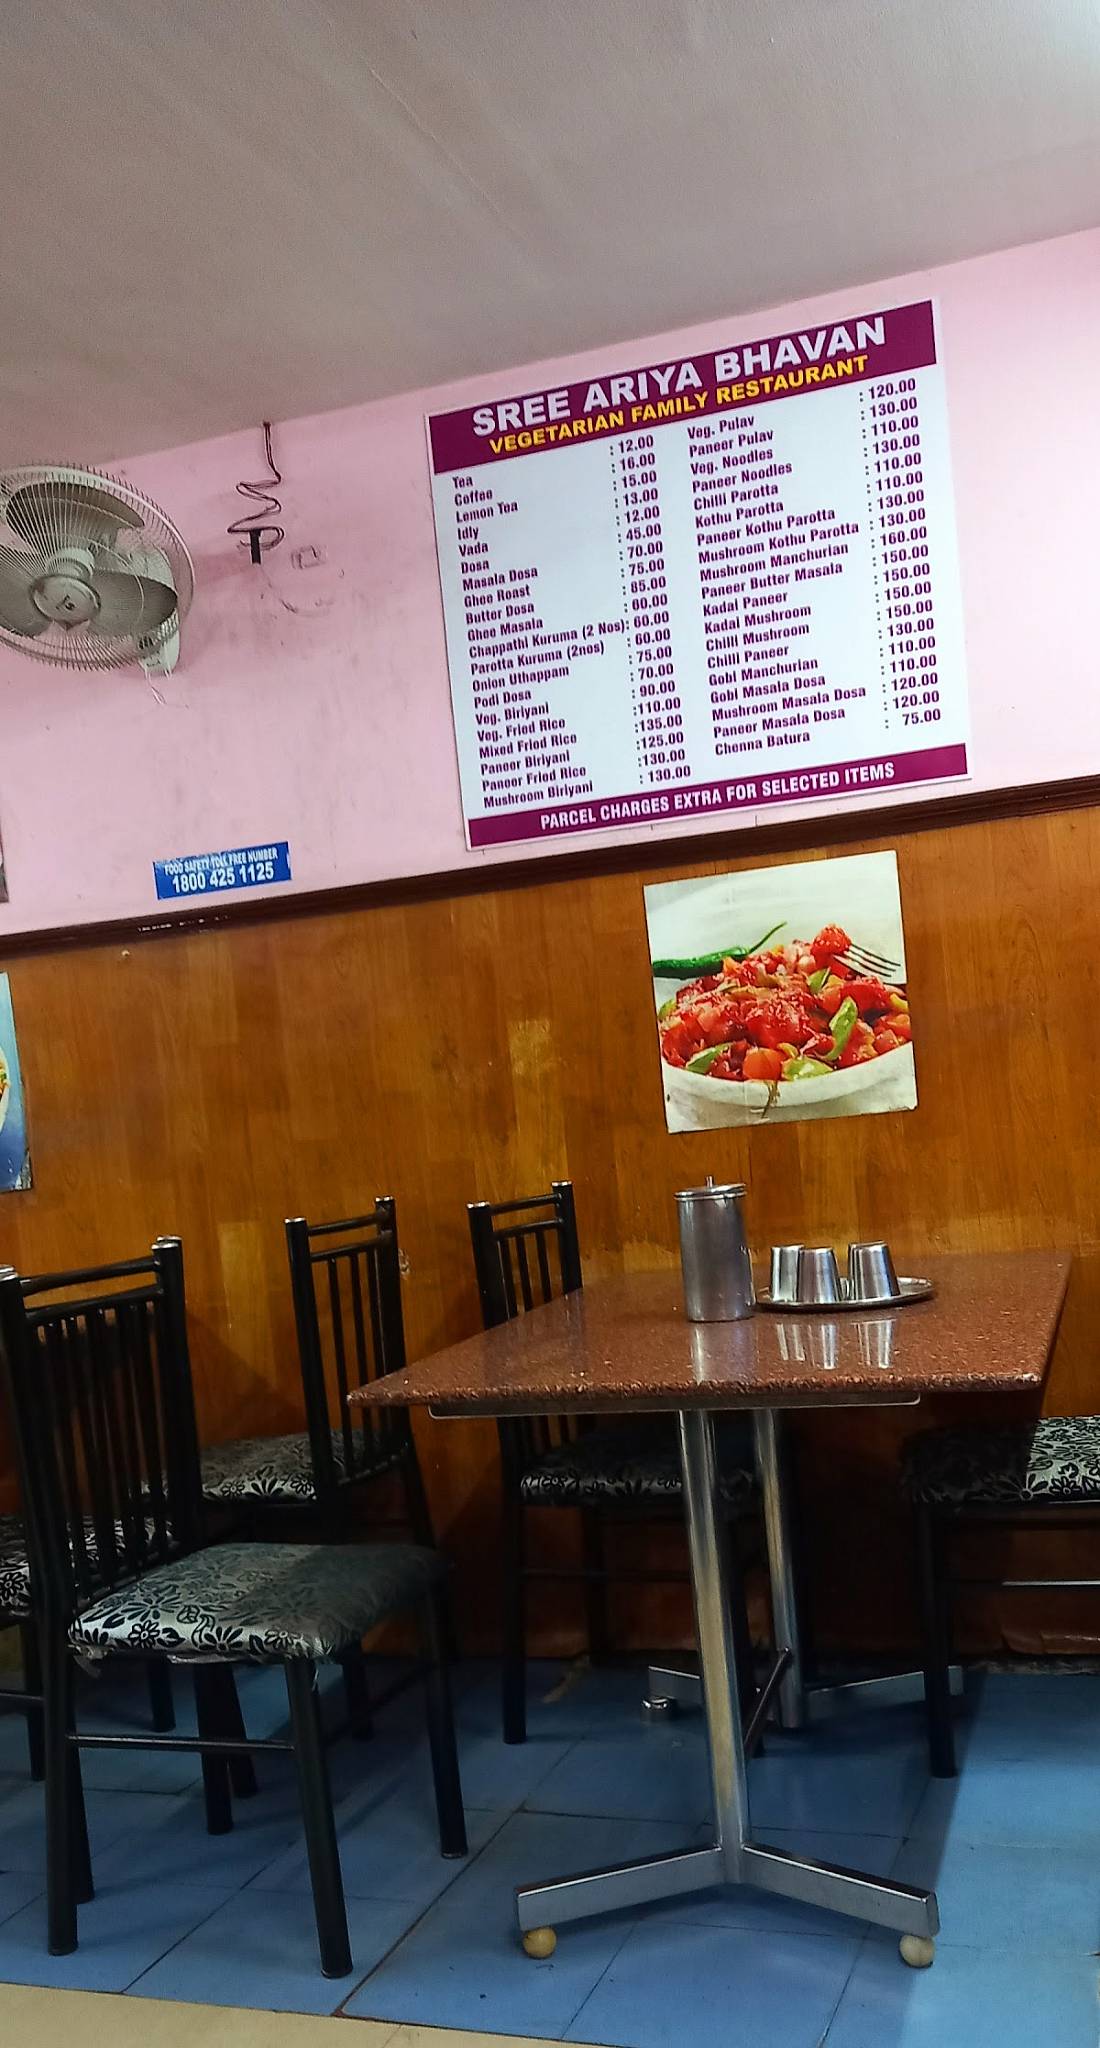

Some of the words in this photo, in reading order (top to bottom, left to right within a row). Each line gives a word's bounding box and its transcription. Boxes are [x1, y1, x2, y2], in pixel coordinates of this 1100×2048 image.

[473, 390, 570, 435] SREE
[584, 362, 702, 412] ARIYA
[715, 317, 885, 382] BHAVAN
[490, 411, 624, 453] VEGETARIAN
[631, 392, 707, 422] FAMILY
[717, 355, 868, 404] RESTAURANT
[687, 426, 716, 440] Veg.
[719, 416, 754, 433] Pulav
[868, 377, 916, 400] 120.00
[689, 439, 734, 459] Paneer
[738, 430, 774, 447] Pulav
[870, 396, 917, 418] 130.00
[452, 476, 473, 489] Tea
[618, 434, 654, 454] 12.00
[690, 461, 718, 476] Veg.
[722, 449, 773, 469] Noodles
[871, 415, 919, 437] 110.00
[692, 475, 737, 494] Paneer
[741, 463, 792, 484] Noodles
[872, 433, 920, 455] 130.00
[454, 489, 493, 507] Coffee
[619, 452, 656, 471] 16.00
[456, 506, 494, 524] Lemon
[497, 501, 519, 515] Tea
[621, 470, 657, 489] 15.00
[695, 512, 732, 529] Kothu
[736, 501, 784, 521] Parotta
[875, 470, 923, 491] 110.00
[730, 484, 779, 504] Parotta
[874, 452, 922, 473] 110.00
[457, 525, 479, 541] Idly
[622, 487, 658, 507] 13.00
[458, 541, 489, 557] Vada
[624, 505, 660, 524] 12.00
[697, 528, 742, 547] Paneer
[745, 520, 782, 537] Kothu
[786, 509, 836, 529] Parotta
[877, 489, 924, 510] 130.00
[698, 542, 765, 564] Mushroom
[769, 533, 806, 551] Kothu
[810, 522, 859, 542] Parotta
[878, 507, 926, 528] 130.00
[460, 560, 490, 575] Dosa
[626, 522, 662, 541] 45.00
[462, 572, 506, 592] Masala
[509, 567, 538, 583] Dosa
[627, 540, 663, 559] 70.00
[700, 560, 766, 582] Mushroom
[770, 544, 849, 568] Manchurian
[880, 526, 927, 546] 160.00
[701, 582, 746, 600] Paneer
[750, 573, 790, 590] Butter
[794, 562, 843, 582] Masala
[881, 544, 929, 565] 150.00
[464, 594, 493, 608] Ghee
[496, 584, 530, 602] Roast
[628, 558, 665, 576] 75.00
[465, 609, 502, 626] Butter
[505, 603, 535, 618] Dosa
[630, 575, 666, 594] 85.00
[742, 592, 788, 610] Paneer
[883, 562, 930, 583] 150.00
[744, 606, 811, 627] Mushroom
[884, 581, 932, 601] 150.00
[467, 627, 496, 642] Ghee
[500, 617, 544, 637] Masala
[632, 593, 668, 611] 60.00
[469, 635, 529, 659] Chappathi
[532, 629, 578, 648] Kuruma
[582, 624, 594, 641] (2
[633, 610, 670, 629] 60.00
[742, 624, 810, 646] Mushroom
[886, 599, 933, 619] 150.00
[744, 646, 789, 663] Paneer
[887, 618, 934, 637] 130.00
[470, 658, 514, 676] Parotta
[517, 650, 563, 668] Kuruma
[566, 640, 604, 661] (2nos)
[635, 628, 671, 646] 60.00
[472, 677, 506, 693] Onion
[509, 666, 569, 686] Uthappam
[636, 645, 672, 663] 75.00
[741, 658, 818, 682] Manchurian
[889, 636, 936, 655] 110.00
[742, 680, 790, 699] Masala
[793, 676, 826, 690] Dosa
[890, 654, 937, 673] 110.00
[475, 712, 501, 726] Veg.
[504, 701, 549, 721] Biriyani
[639, 680, 676, 697] 90.00
[502, 690, 532, 704] Dosa
[638, 662, 674, 681] 70.00
[712, 702, 778, 722] Mushroom
[782, 692, 830, 710] Masala
[834, 687, 866, 701] Dosa
[891, 672, 938, 691] 120.00
[477, 729, 503, 743] Veg.
[505, 720, 536, 738] Fried
[539, 718, 566, 732] Rice
[713, 722, 758, 739] Paneer
[762, 712, 809, 731] Masala
[813, 709, 845, 723] Dosa
[893, 690, 940, 709] 120.00
[767, 732, 810, 748] Batura
[902, 708, 941, 726] 75.00
[479, 741, 514, 759] Mixed
[517, 736, 547, 753] Fried
[550, 733, 577, 747] Rice
[480, 760, 521, 776] Paneer
[524, 749, 570, 769] Biriyani
[482, 776, 523, 792] Paneer
[526, 768, 557, 785] Fried
[560, 766, 586, 780] Rice
[483, 790, 544, 809] Mushroom
[547, 780, 593, 799] Biriyani
[648, 765, 691, 783] 130.00
[541, 808, 596, 829] PARCEL
[600, 796, 669, 820] CHARGES
[674, 789, 722, 809] EXTRA
[726, 783, 757, 802] FOR
[762, 771, 839, 796] SELECTED
[845, 762, 894, 784] ITEMS
[164, 862, 184, 876] FOOD
[184, 859, 210, 873] SAFETY
[229, 853, 248, 866] FREE
[248, 848, 278, 862] NUMBER
[172, 871, 206, 893] 1800
[210, 867, 236, 888] 425
[239, 861, 274, 884] 1125
